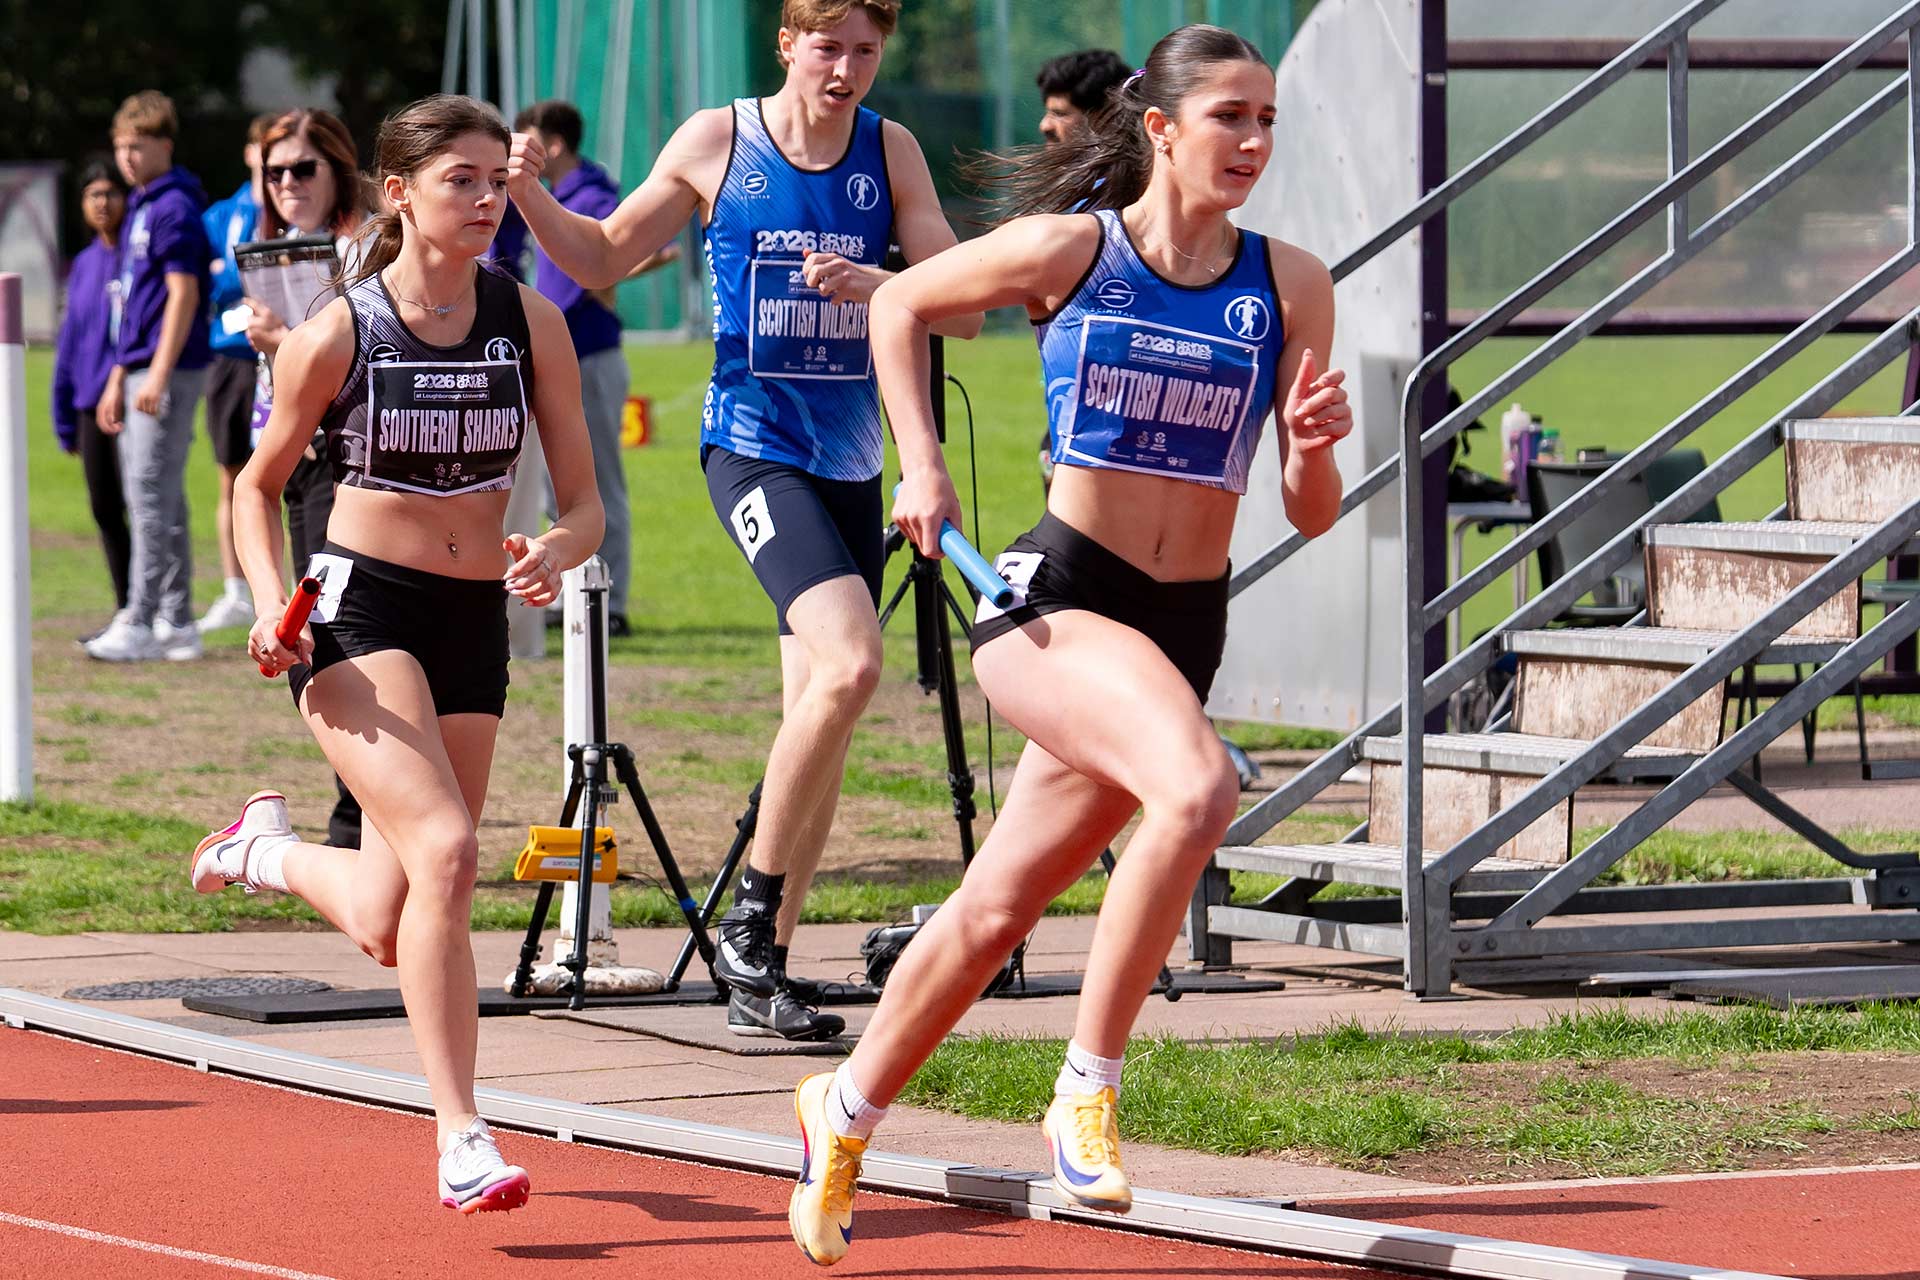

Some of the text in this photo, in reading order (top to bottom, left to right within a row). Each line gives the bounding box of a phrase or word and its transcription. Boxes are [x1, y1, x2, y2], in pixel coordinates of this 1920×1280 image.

[756, 230, 817, 252] 2026
[820, 232, 865, 248] SCHOOL
[820, 239, 864, 258] GAMES
[758, 298, 868, 339] SCOTTISH WILDCATS
[1130, 332, 1175, 353] 2026
[414, 374, 455, 388] 2026
[456, 381, 488, 389] GAMES
[1085, 363, 1241, 432] SCOTTISH WILDCATS
[379, 406, 519, 453] SOUTHERN SHARKS
[741, 503, 759, 544] 5
